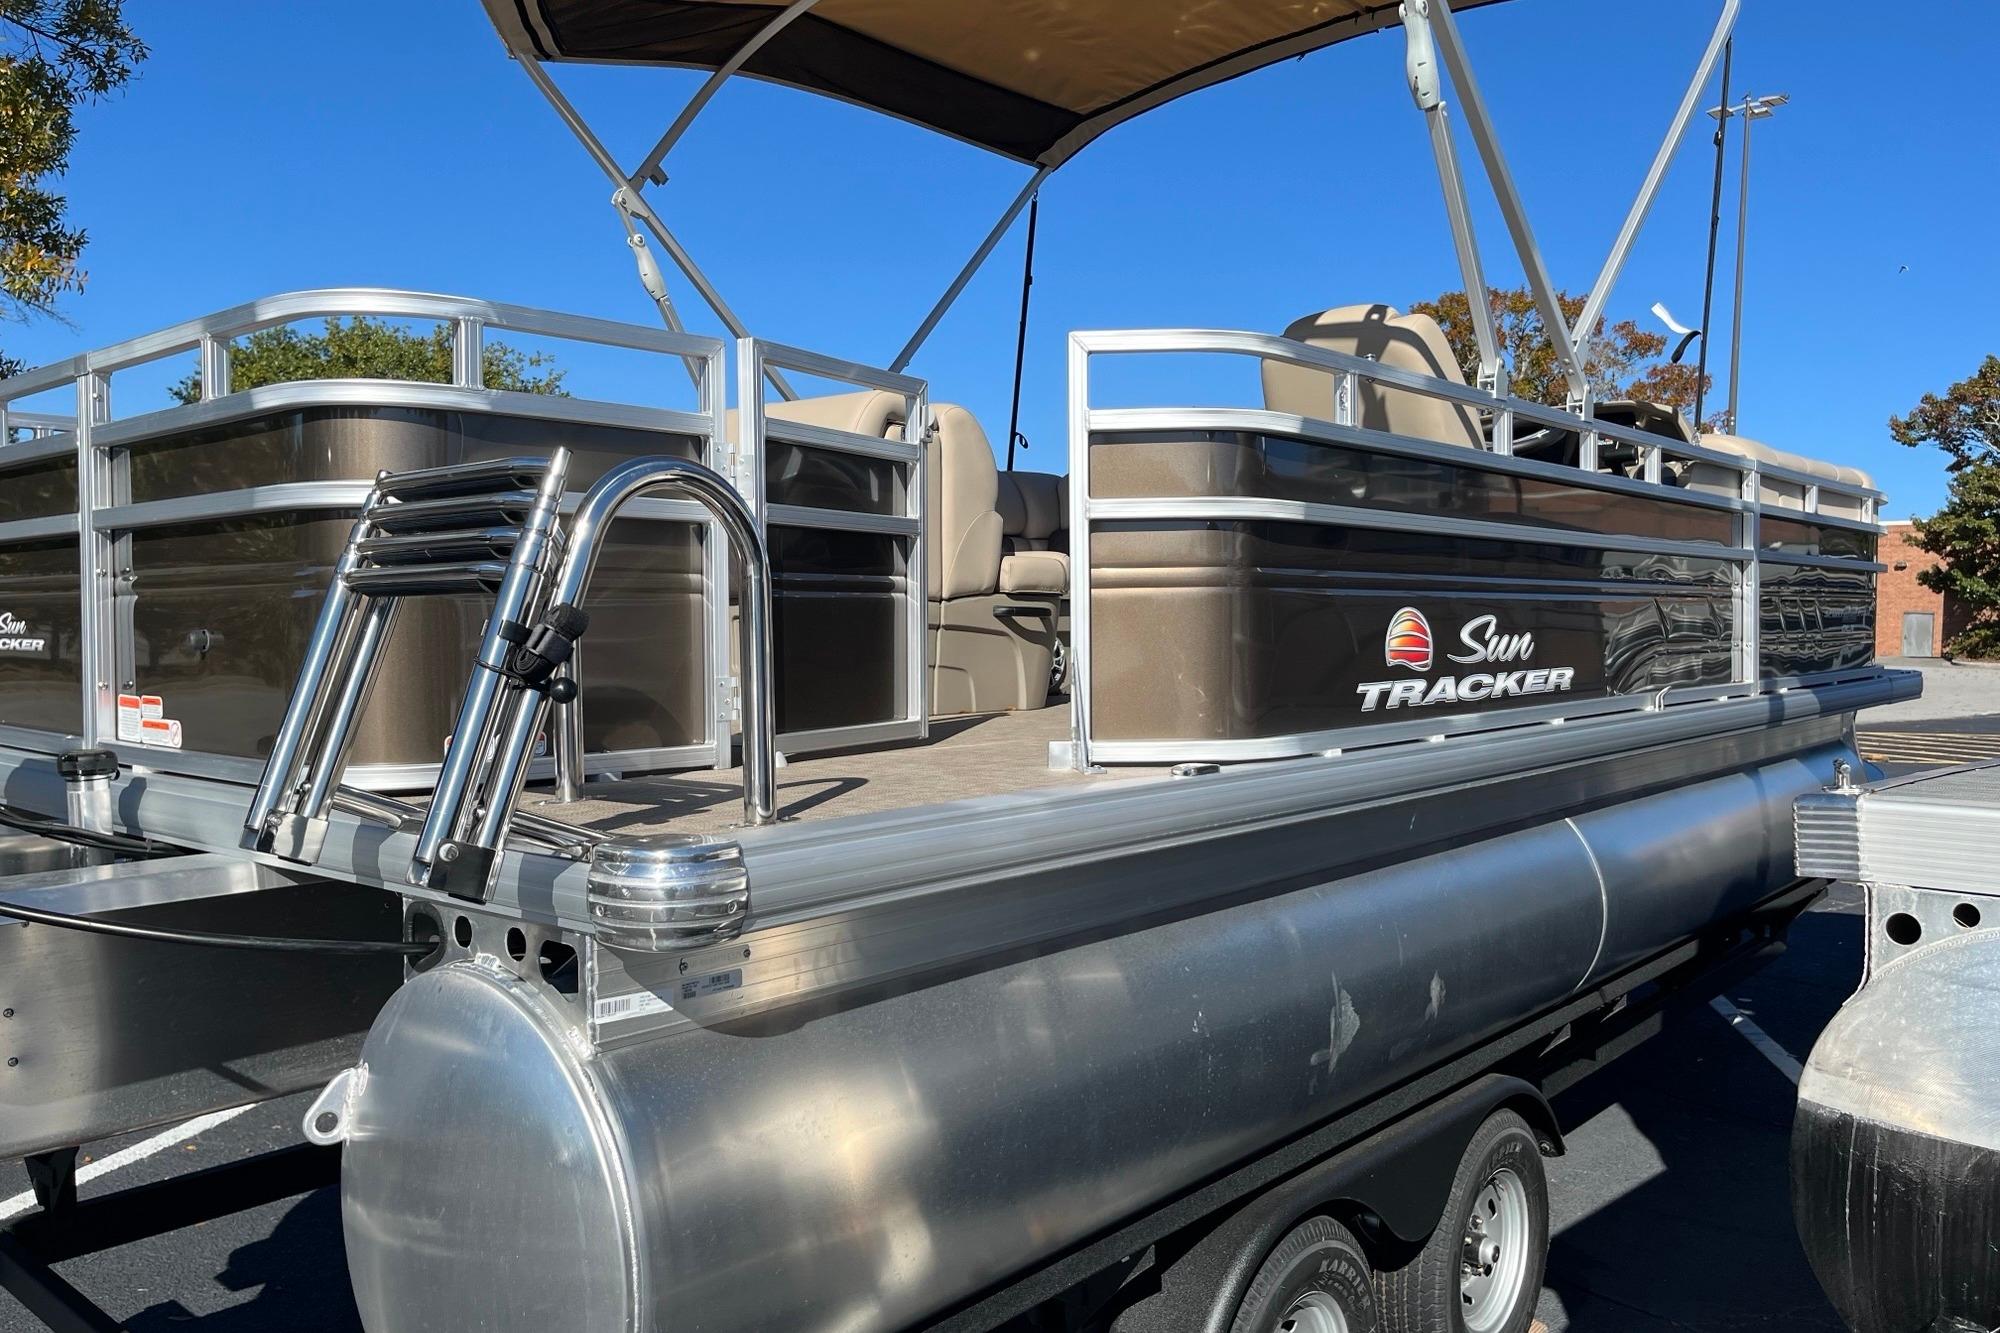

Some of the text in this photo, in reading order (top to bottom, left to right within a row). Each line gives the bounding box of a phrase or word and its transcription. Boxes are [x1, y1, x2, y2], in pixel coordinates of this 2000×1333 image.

[0, 611, 27, 635] Sun
[1447, 614, 1535, 664] Sun
[1356, 666, 1575, 712] TRACKER
